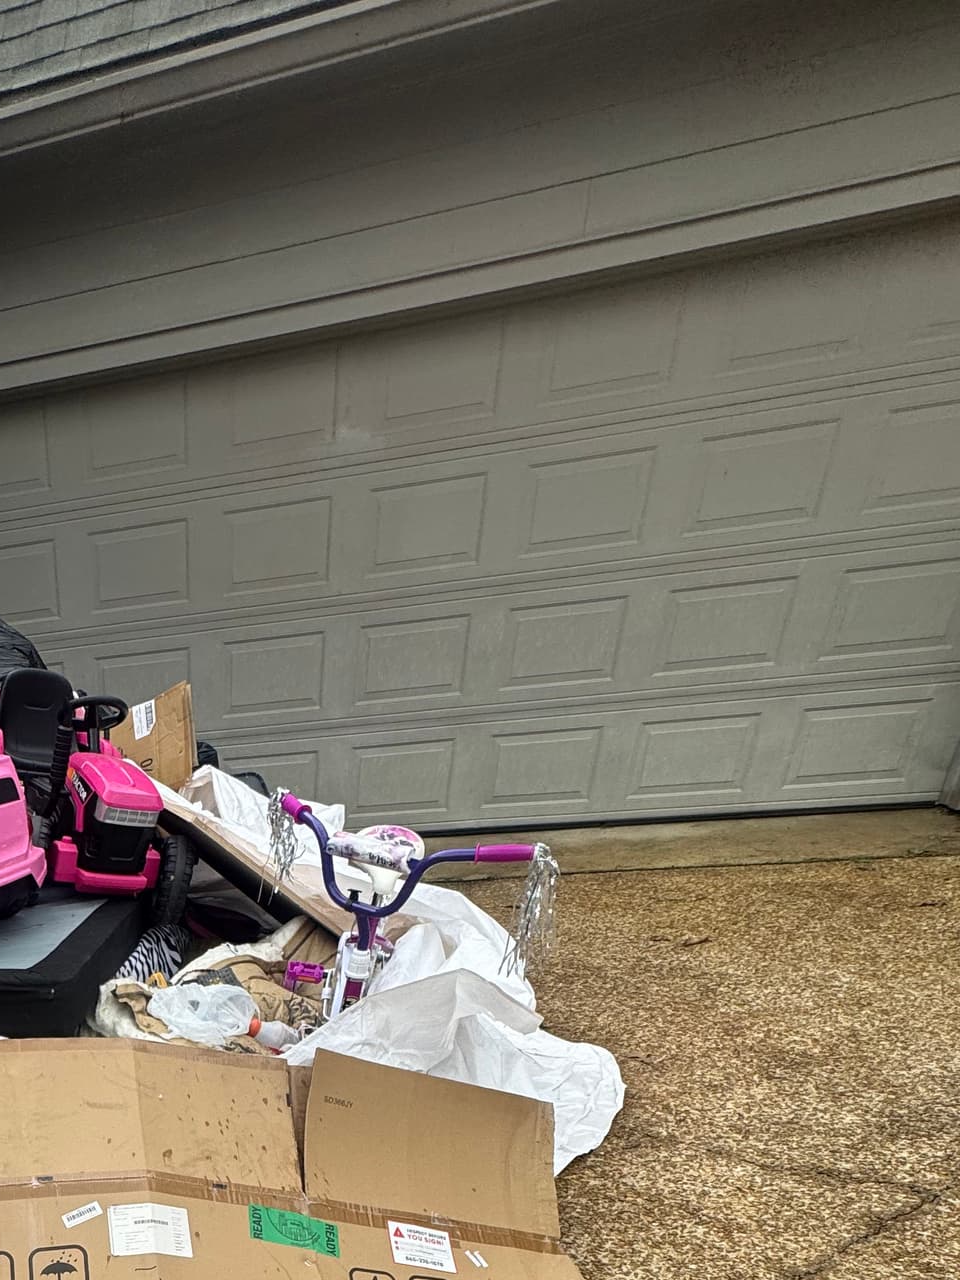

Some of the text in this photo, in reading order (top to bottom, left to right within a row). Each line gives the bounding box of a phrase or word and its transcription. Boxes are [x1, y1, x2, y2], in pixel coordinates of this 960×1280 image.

[251, 1205, 263, 1240] READY
[407, 1234, 422, 1242] YOU
[324, 1223, 336, 1257] READY
